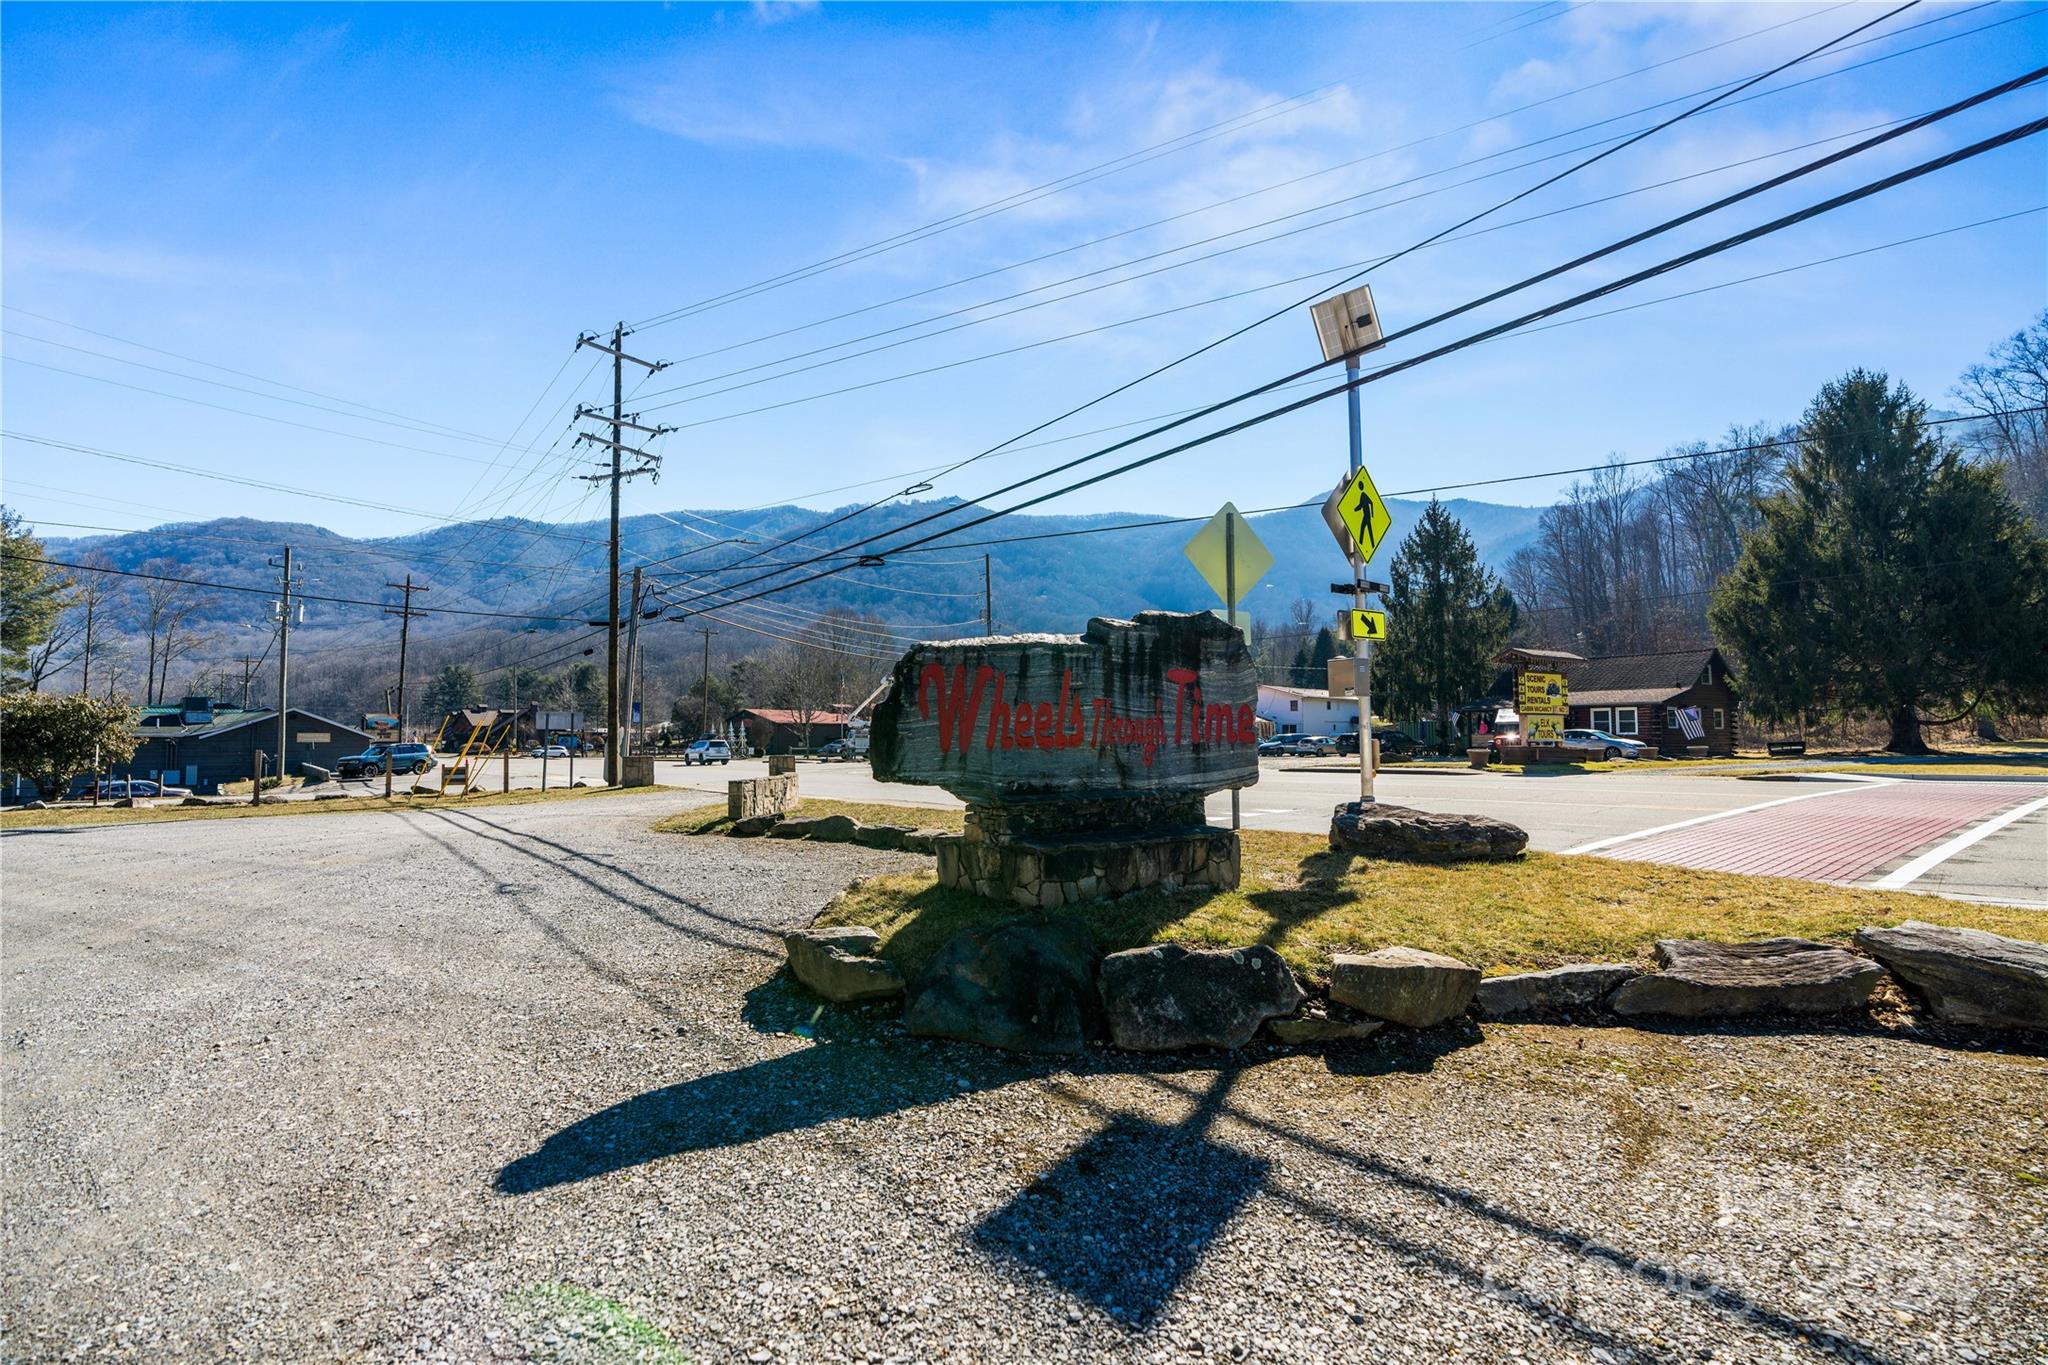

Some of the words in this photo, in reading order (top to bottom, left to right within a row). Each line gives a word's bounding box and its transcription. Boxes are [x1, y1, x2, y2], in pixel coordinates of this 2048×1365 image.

[1526, 675, 1546, 683] SCENIC
[1526, 686, 1545, 694] TOURS
[1526, 696, 1551, 704] RENTALS
[918, 663, 1084, 755] Wheels
[1090, 697, 1167, 767] Through
[1167, 668, 1256, 746] Time
[1541, 719, 1550, 727] ELK
[1538, 730, 1554, 739] TOURS
